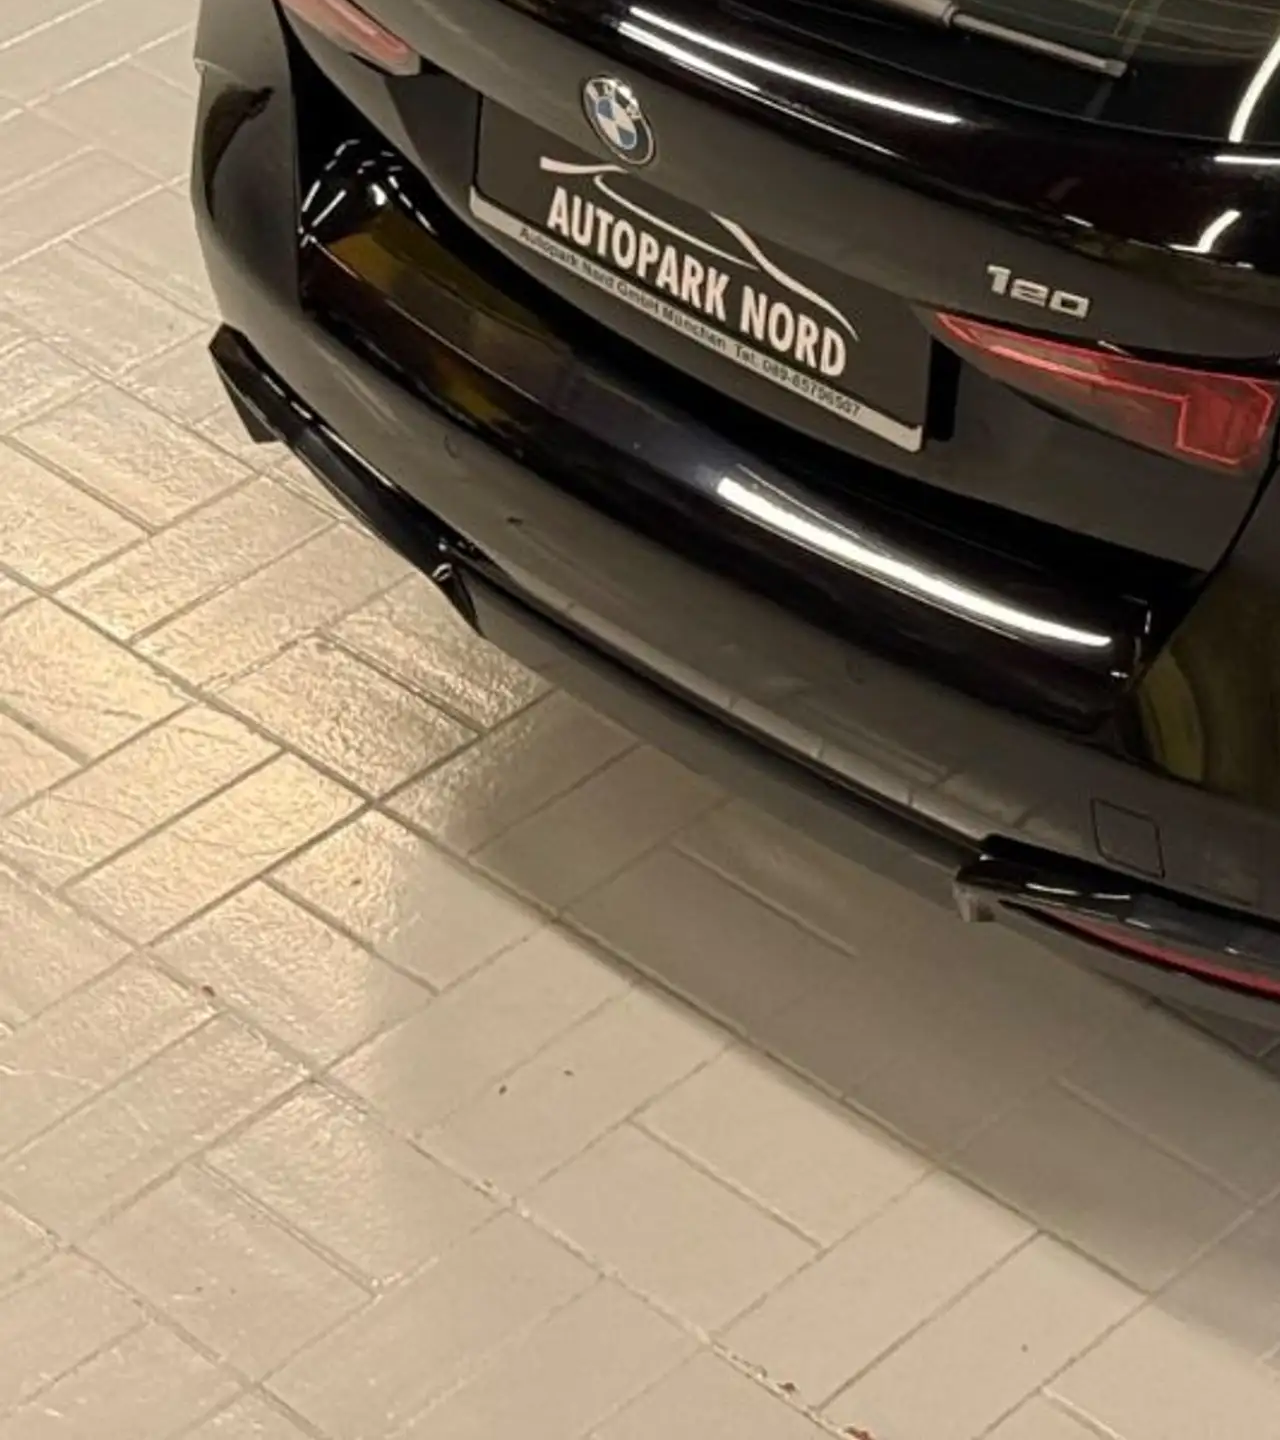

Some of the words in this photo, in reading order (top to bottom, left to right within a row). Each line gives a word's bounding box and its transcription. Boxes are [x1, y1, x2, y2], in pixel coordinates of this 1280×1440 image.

[546, 185, 728, 322] AUTOPARK
[740, 285, 847, 377] NORD
[986, 263, 1090, 319] 120
